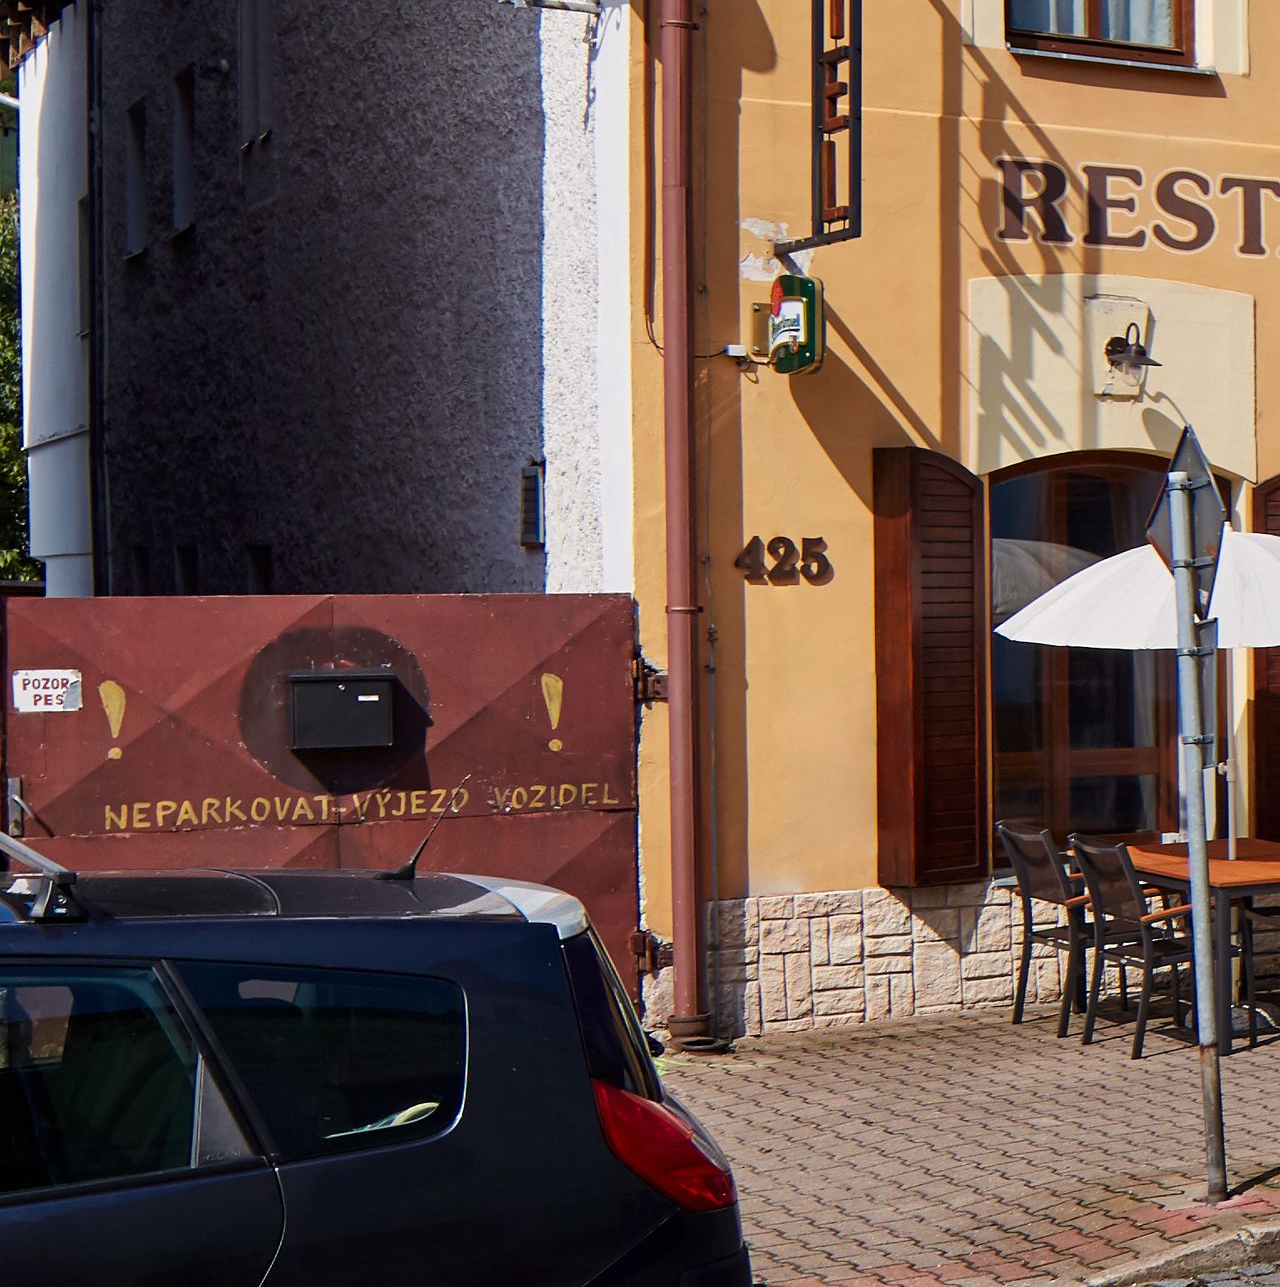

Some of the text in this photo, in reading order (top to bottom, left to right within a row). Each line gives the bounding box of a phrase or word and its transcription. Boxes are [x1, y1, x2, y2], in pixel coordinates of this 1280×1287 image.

[734, 536, 834, 586] 425
[22, 678, 70, 690] POZOR
[33, 694, 64, 706] PES
